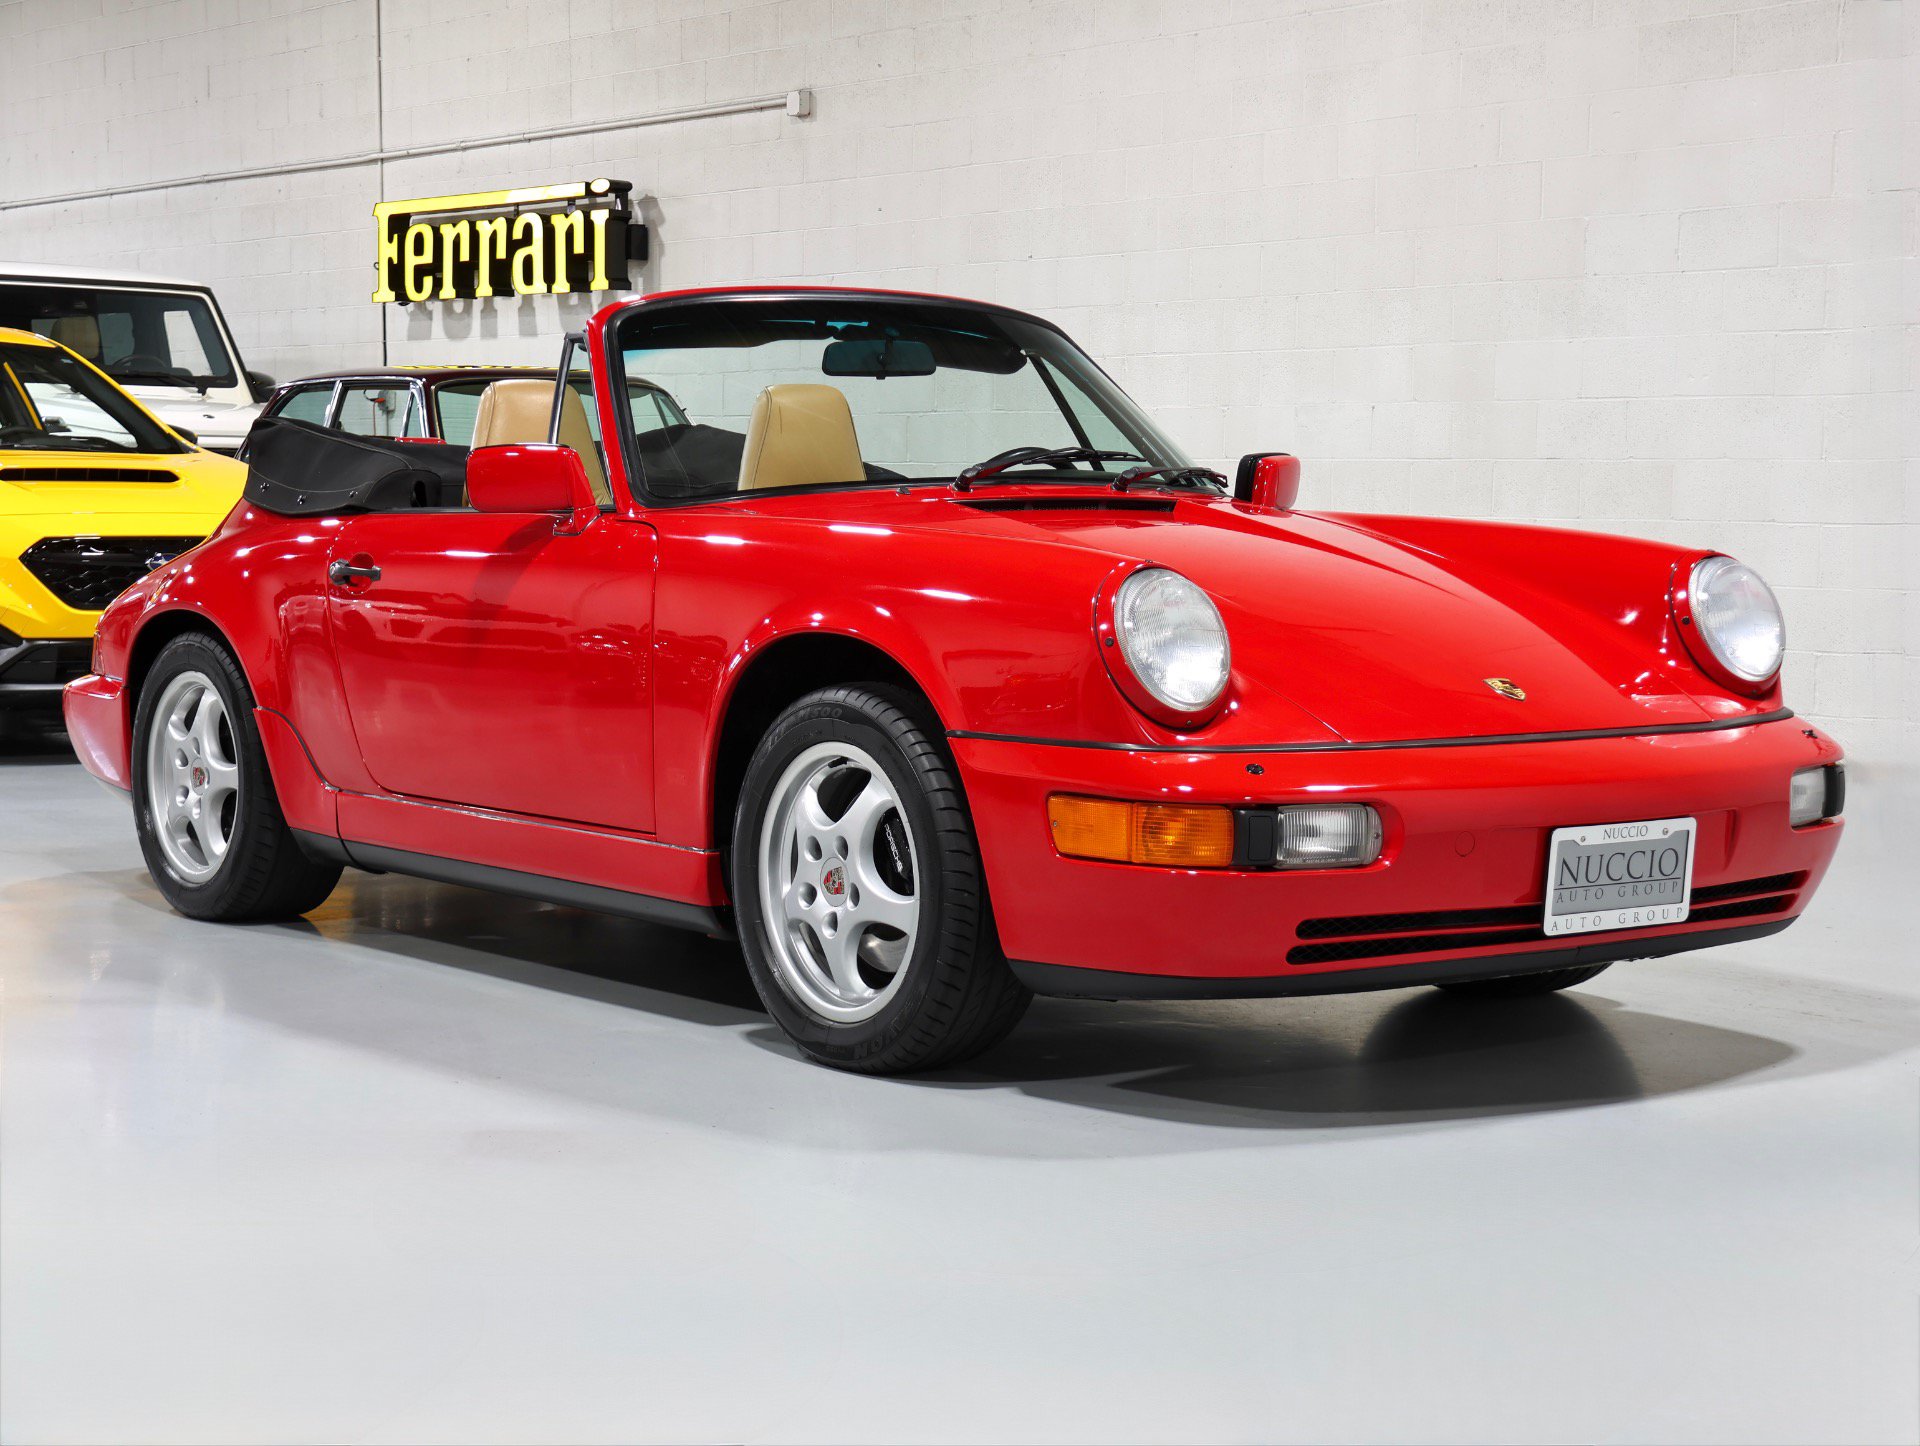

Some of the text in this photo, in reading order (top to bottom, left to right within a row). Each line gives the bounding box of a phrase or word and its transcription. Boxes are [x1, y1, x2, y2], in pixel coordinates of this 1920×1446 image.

[372, 178, 611, 303] Ferrari
[884, 823, 903, 872] PORSCHE
[1603, 826, 1648, 840] NUCCIO
[1559, 848, 1679, 886] NUCCIO
[1556, 882, 1679, 903] AUTO GROUP
[1552, 907, 1683, 932] AUTO GROUP
